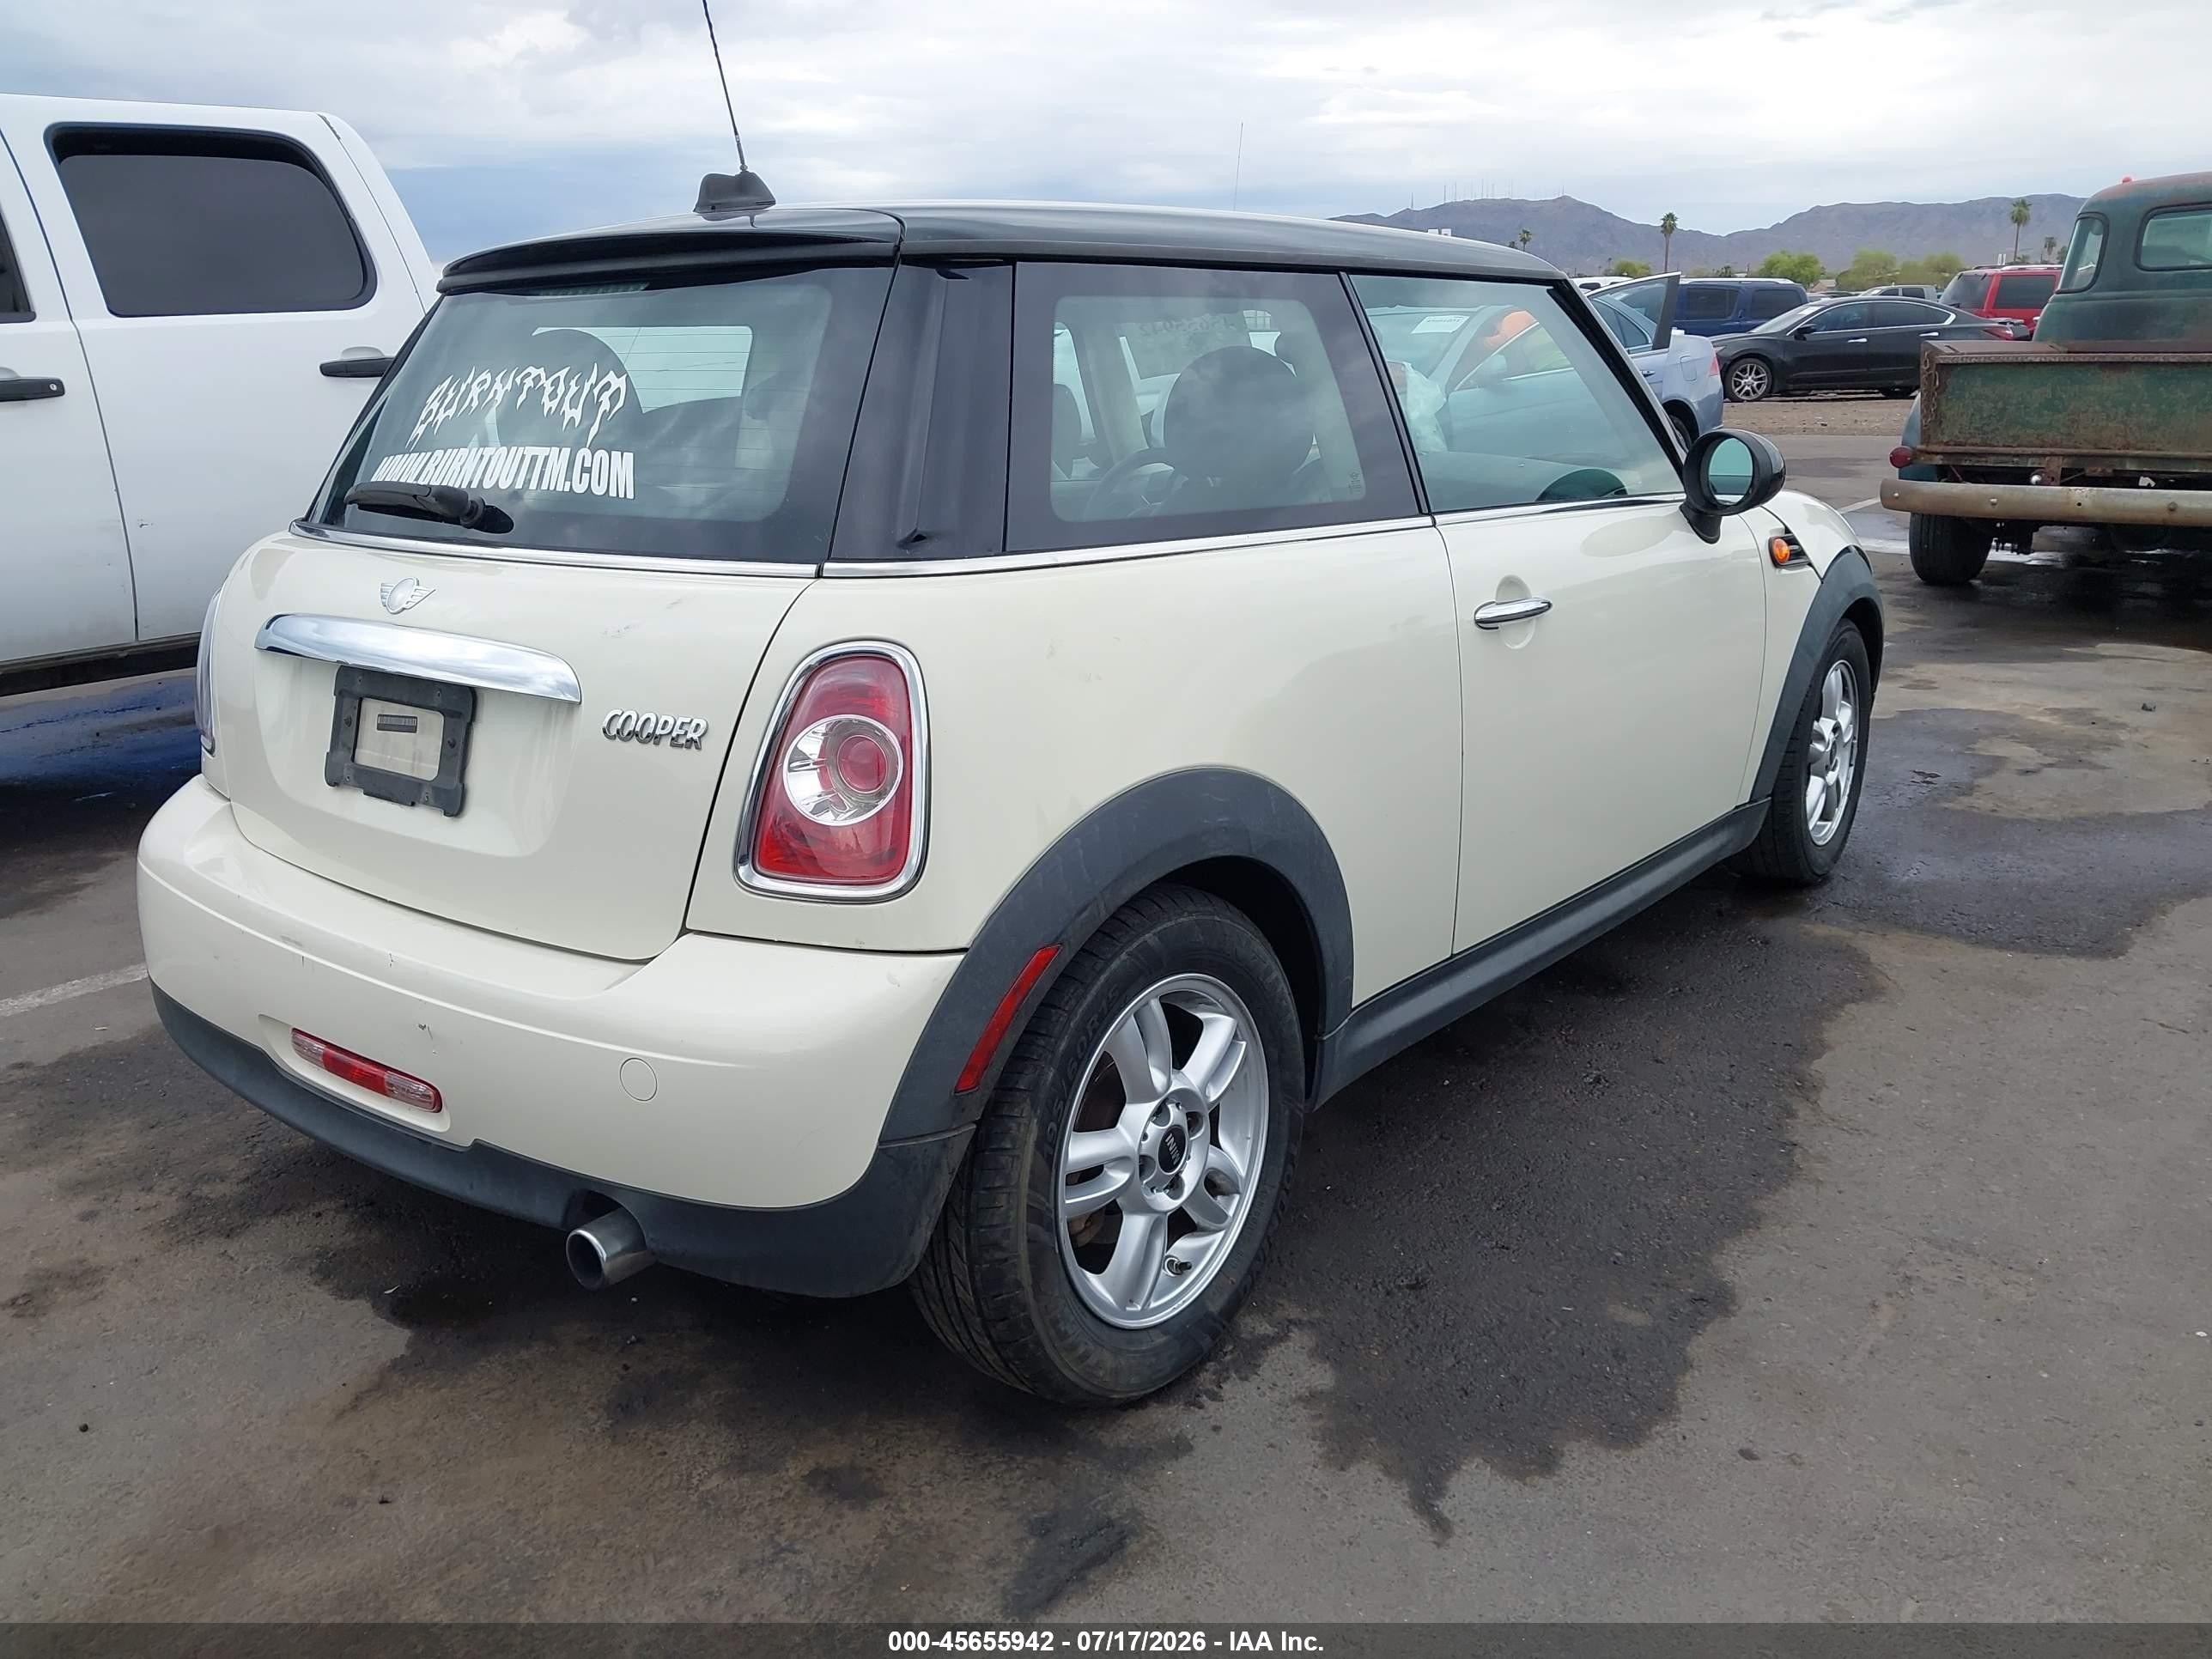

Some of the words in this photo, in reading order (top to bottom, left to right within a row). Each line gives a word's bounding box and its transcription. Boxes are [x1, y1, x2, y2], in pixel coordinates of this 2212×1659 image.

[405, 362, 627, 450] BURNTOUT
[602, 708, 709, 751] COOPER
[1164, 1133, 1181, 1166] MINI
